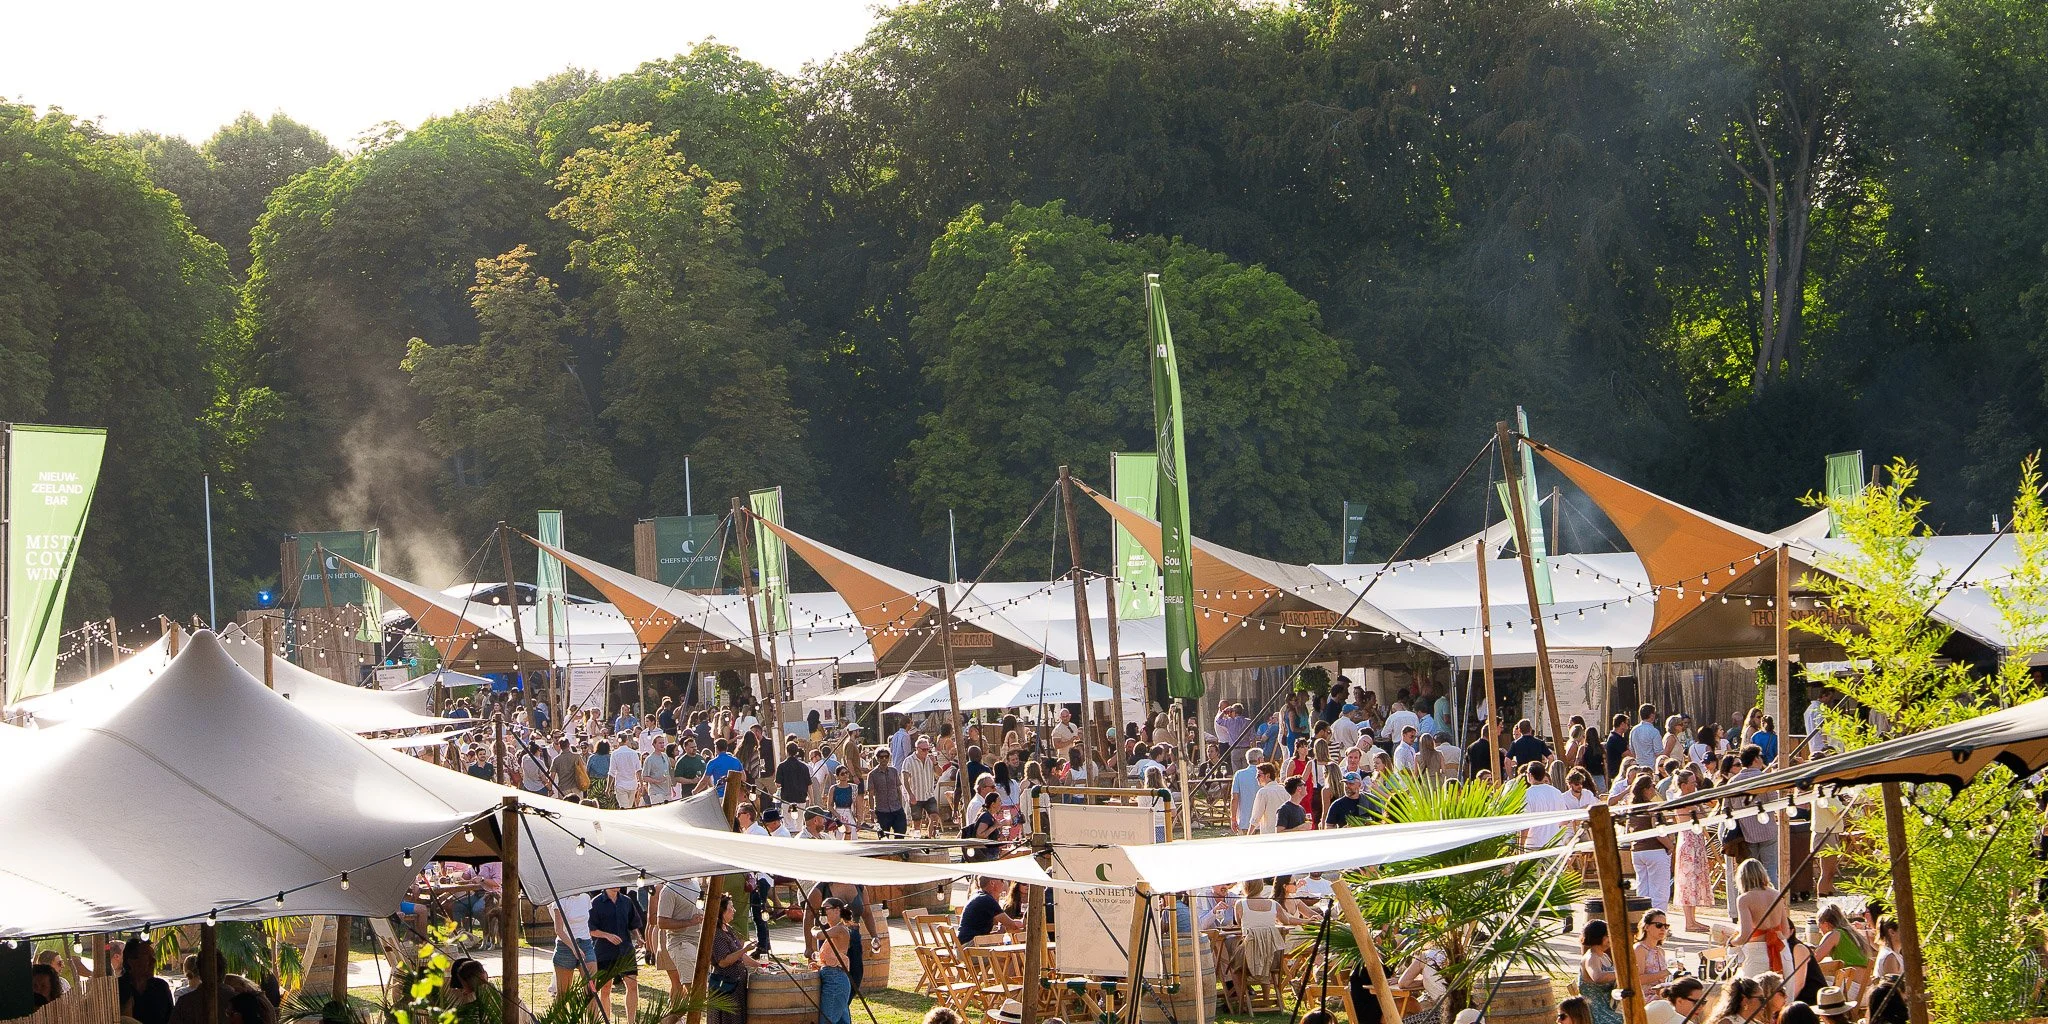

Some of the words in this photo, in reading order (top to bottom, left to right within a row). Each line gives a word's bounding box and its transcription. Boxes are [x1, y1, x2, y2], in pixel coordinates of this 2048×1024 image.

[39, 472, 79, 481] NIEUW-
[31, 483, 83, 494] ZEELAND
[45, 496, 68, 505] BAR
[25, 551, 71, 566] COV
[303, 573, 323, 581] CHEF
[1281, 612, 1310, 626] MARCO
[1313, 612, 1357, 626] HELSLOT
[1752, 611, 1797, 626] THOS
[965, 634, 992, 646] KATARAS
[1095, 888, 1106, 896] IN
[1108, 888, 1127, 897] HET
